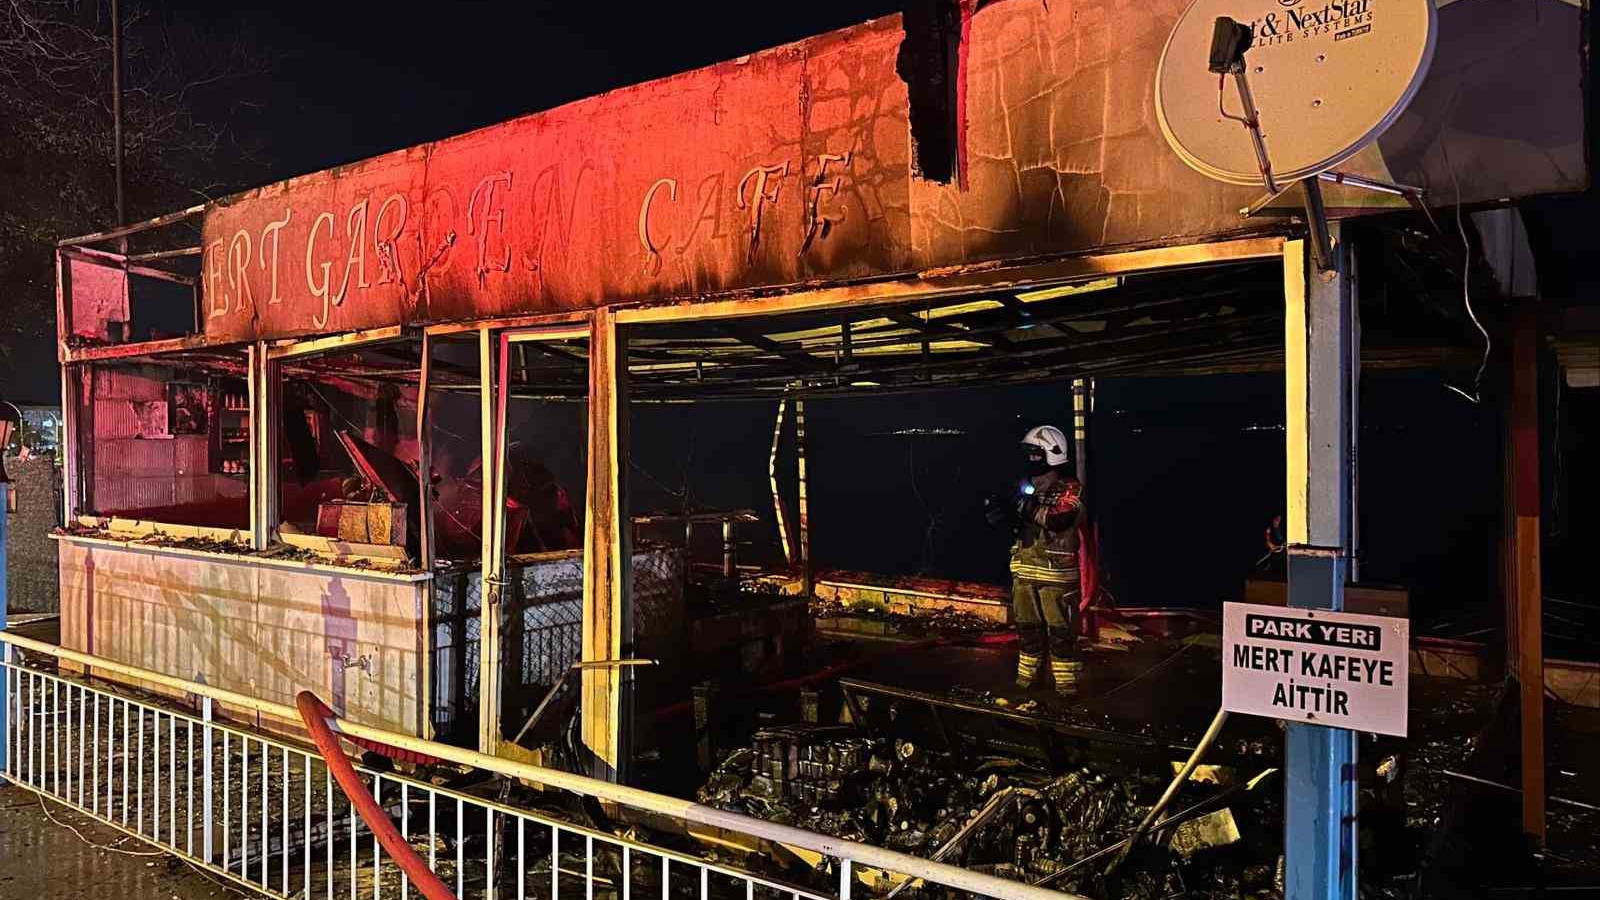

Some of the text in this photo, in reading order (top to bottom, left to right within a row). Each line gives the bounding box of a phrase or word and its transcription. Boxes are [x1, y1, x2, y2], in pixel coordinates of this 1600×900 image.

[1303, 11, 1373, 39] SYSTEMS
[1251, 618, 1313, 640] PARK
[1233, 643, 1393, 686] MERT KAFEYE
[1272, 678, 1349, 716] AİTTİR
